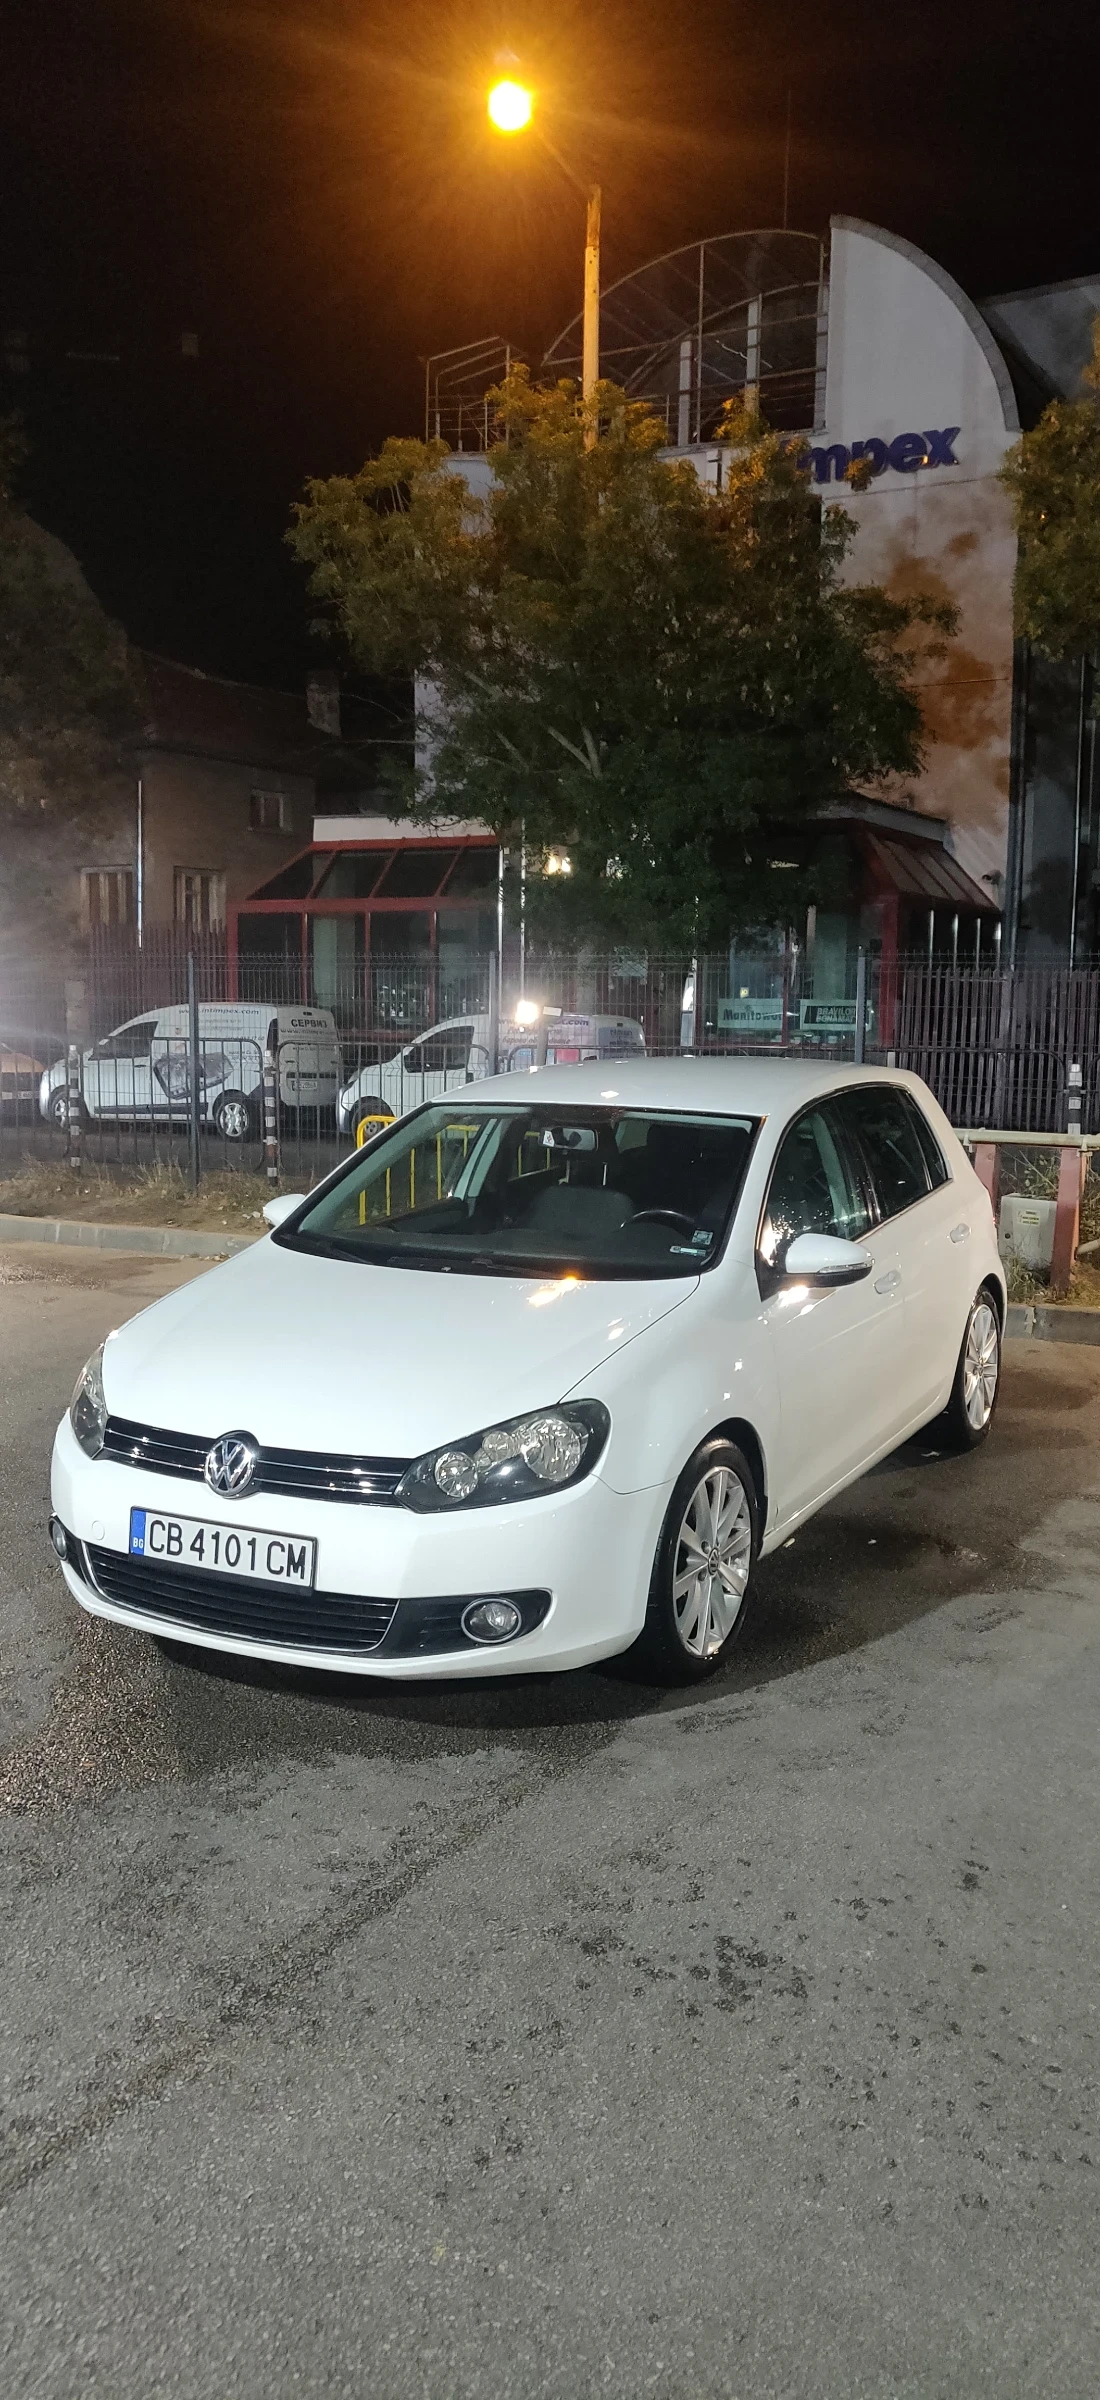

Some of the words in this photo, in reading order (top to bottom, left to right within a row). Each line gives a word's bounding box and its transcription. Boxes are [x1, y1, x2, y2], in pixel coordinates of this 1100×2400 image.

[780, 426, 961, 483] mpex
[178, 1007, 260, 1015] ww.intimpex.com
[290, 1018, 328, 1029] СЕРВИЗ
[132, 1536, 144, 1549] BG
[149, 1519, 184, 1557] CB
[189, 1528, 257, 1572] 4101
[266, 1540, 307, 1580] CM
